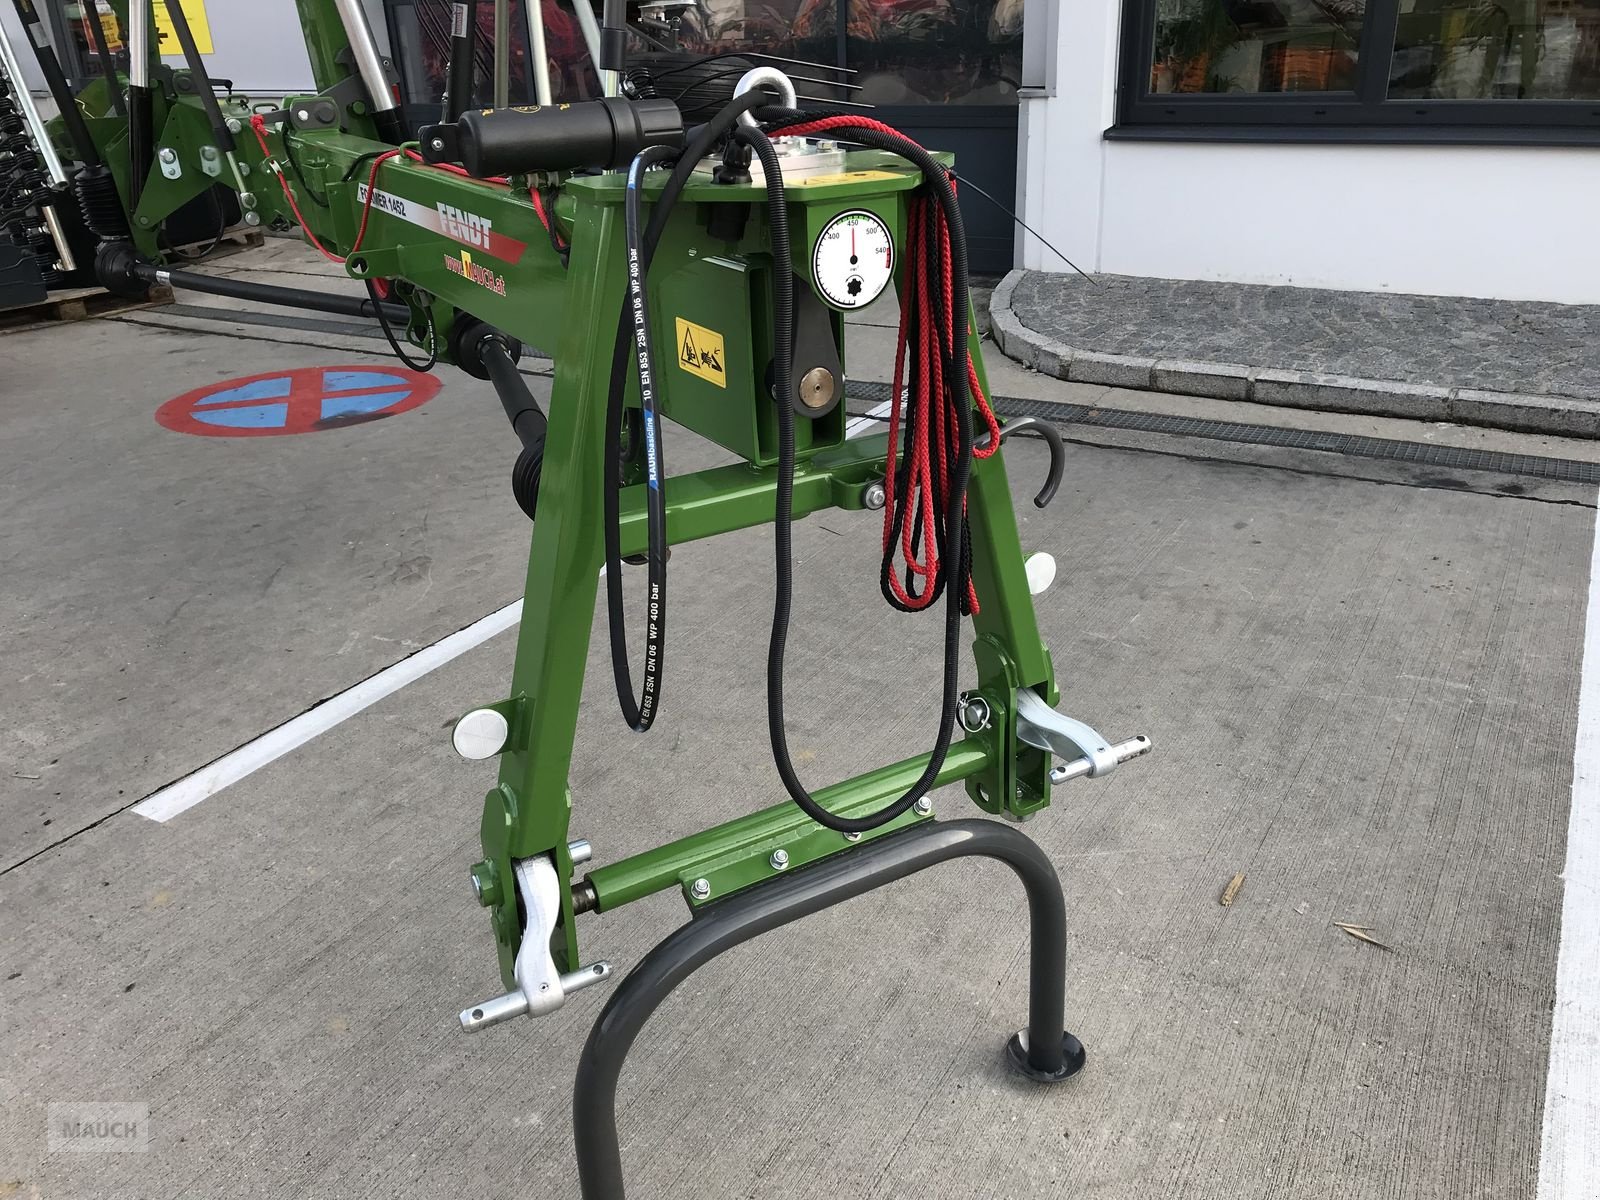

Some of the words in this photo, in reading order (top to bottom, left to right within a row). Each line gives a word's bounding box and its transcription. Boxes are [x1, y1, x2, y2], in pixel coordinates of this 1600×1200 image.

[388, 196, 407, 217] 1452
[436, 201, 492, 250] FENDT
[630, 247, 638, 262] bar
[630, 263, 639, 278] 400
[631, 279, 640, 295] WP
[633, 297, 642, 309] 06
[635, 310, 644, 325] DN
[637, 328, 646, 348] 2SN
[639, 351, 648, 370] 853
[641, 370, 650, 386] EN
[643, 389, 651, 401] 10
[647, 417, 657, 481] RAUHbasicline
[650, 603, 658, 621] 400
[649, 623, 658, 640] WP
[648, 645, 657, 658] 06
[647, 658, 656, 672] DN
[646, 675, 655, 693] 2SN
[644, 695, 653, 709] 853
[642, 707, 651, 718] EN
